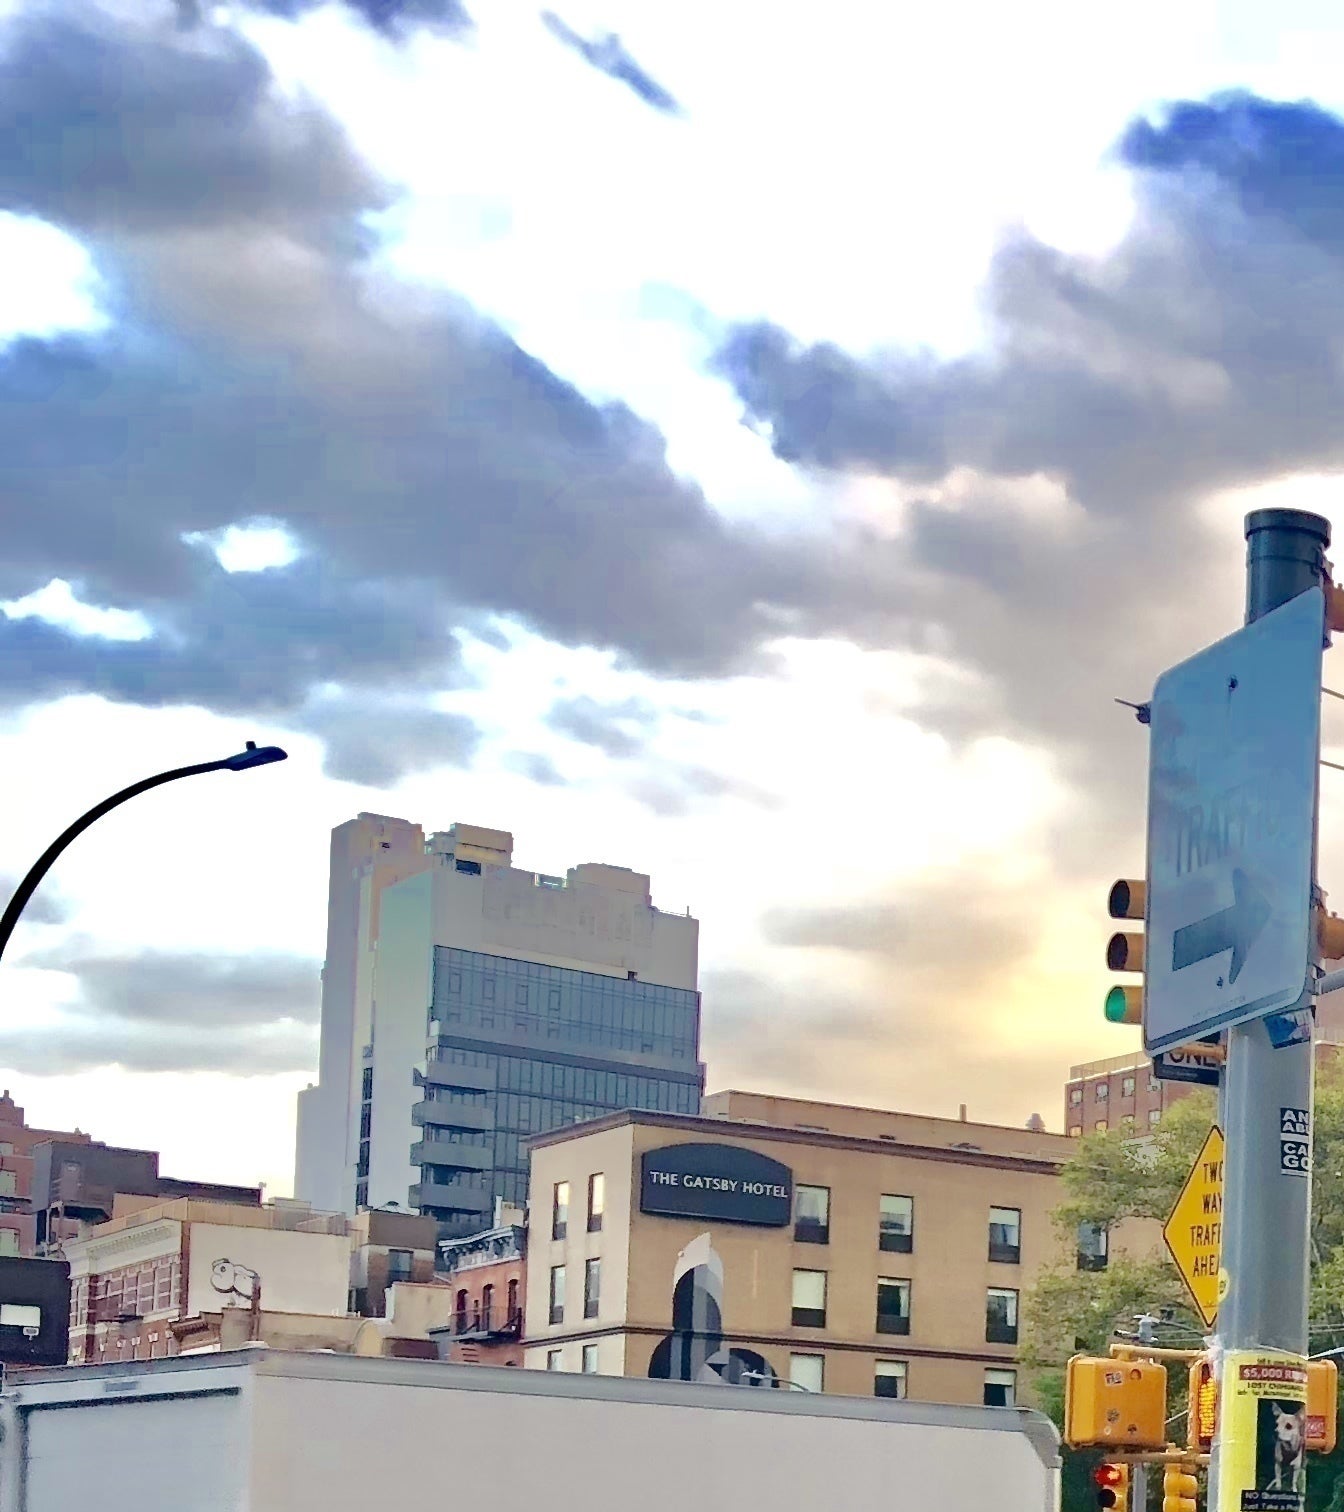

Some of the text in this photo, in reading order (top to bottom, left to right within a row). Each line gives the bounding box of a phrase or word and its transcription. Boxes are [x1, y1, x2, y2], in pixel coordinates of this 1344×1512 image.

[650, 1171, 788, 1198] THE GATSBY HOTEL
[1243, 1367, 1283, 1380] $5,000
